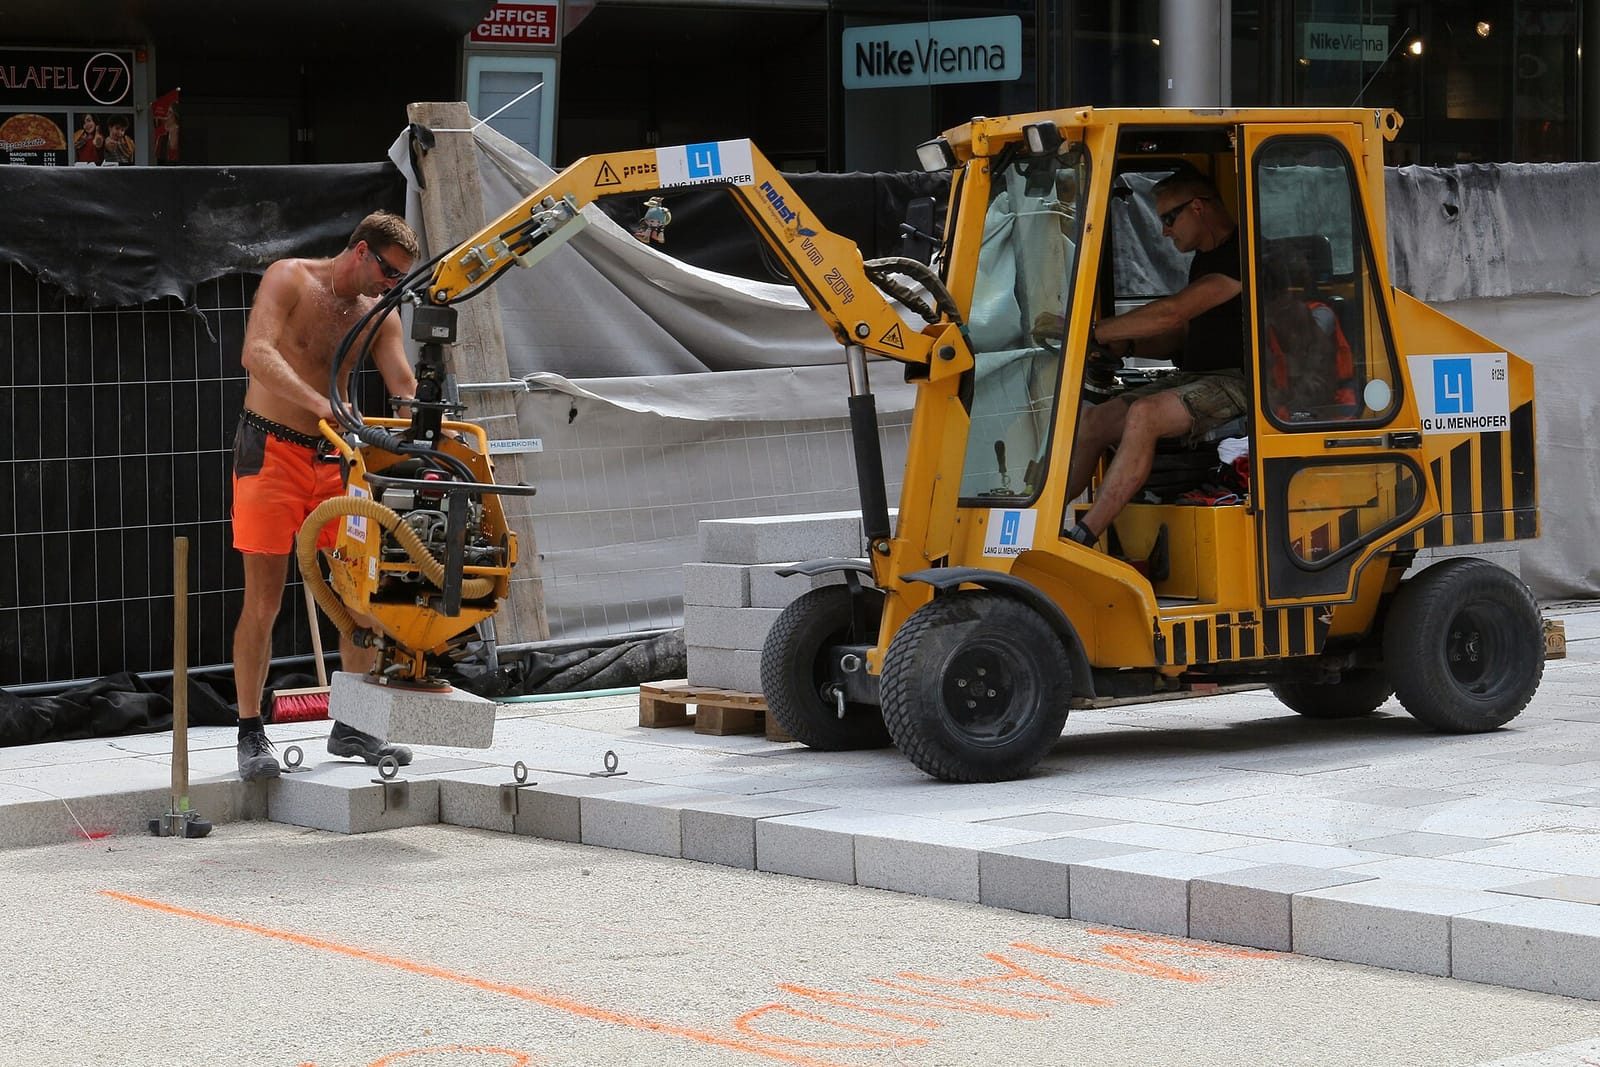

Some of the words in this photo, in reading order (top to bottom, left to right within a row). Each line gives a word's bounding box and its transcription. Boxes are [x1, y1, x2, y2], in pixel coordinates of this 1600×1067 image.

[477, 24, 550, 38] CENTER
[92, 66, 123, 92] 77
[823, 267, 855, 305] 204
[1447, 415, 1507, 429] MENHOFER
[490, 440, 538, 449] HABERKORN
[984, 546, 997, 554] LANG
